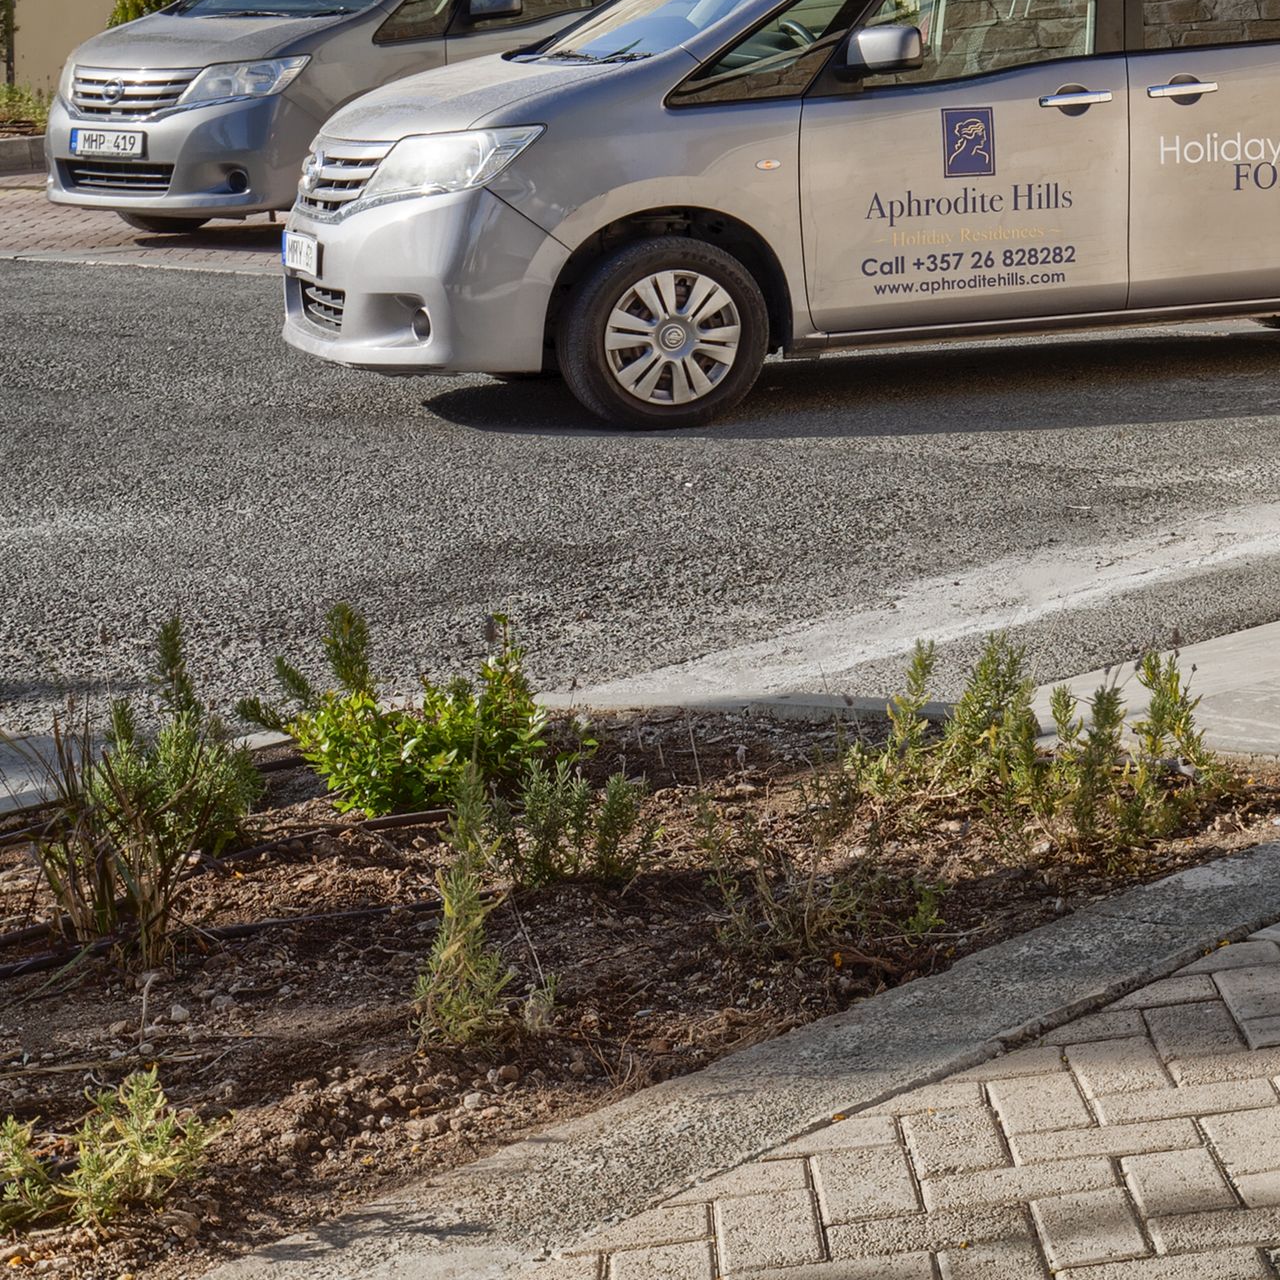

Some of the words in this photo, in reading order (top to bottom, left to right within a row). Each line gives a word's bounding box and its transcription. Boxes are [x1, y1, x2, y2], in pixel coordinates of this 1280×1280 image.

[83, 134, 106, 150] MHP
[113, 135, 136, 151] 419
[865, 187, 1003, 227] Aphrodite
[1011, 182, 1073, 211] Hills
[892, 230, 954, 248] Holiday
[960, 224, 1044, 242] Residences
[861, 256, 905, 276] Call
[913, 252, 964, 272] +357
[970, 251, 995, 269] 26
[1002, 246, 1076, 267] 828282
[874, 272, 1065, 295] www.aphroditehills.com
